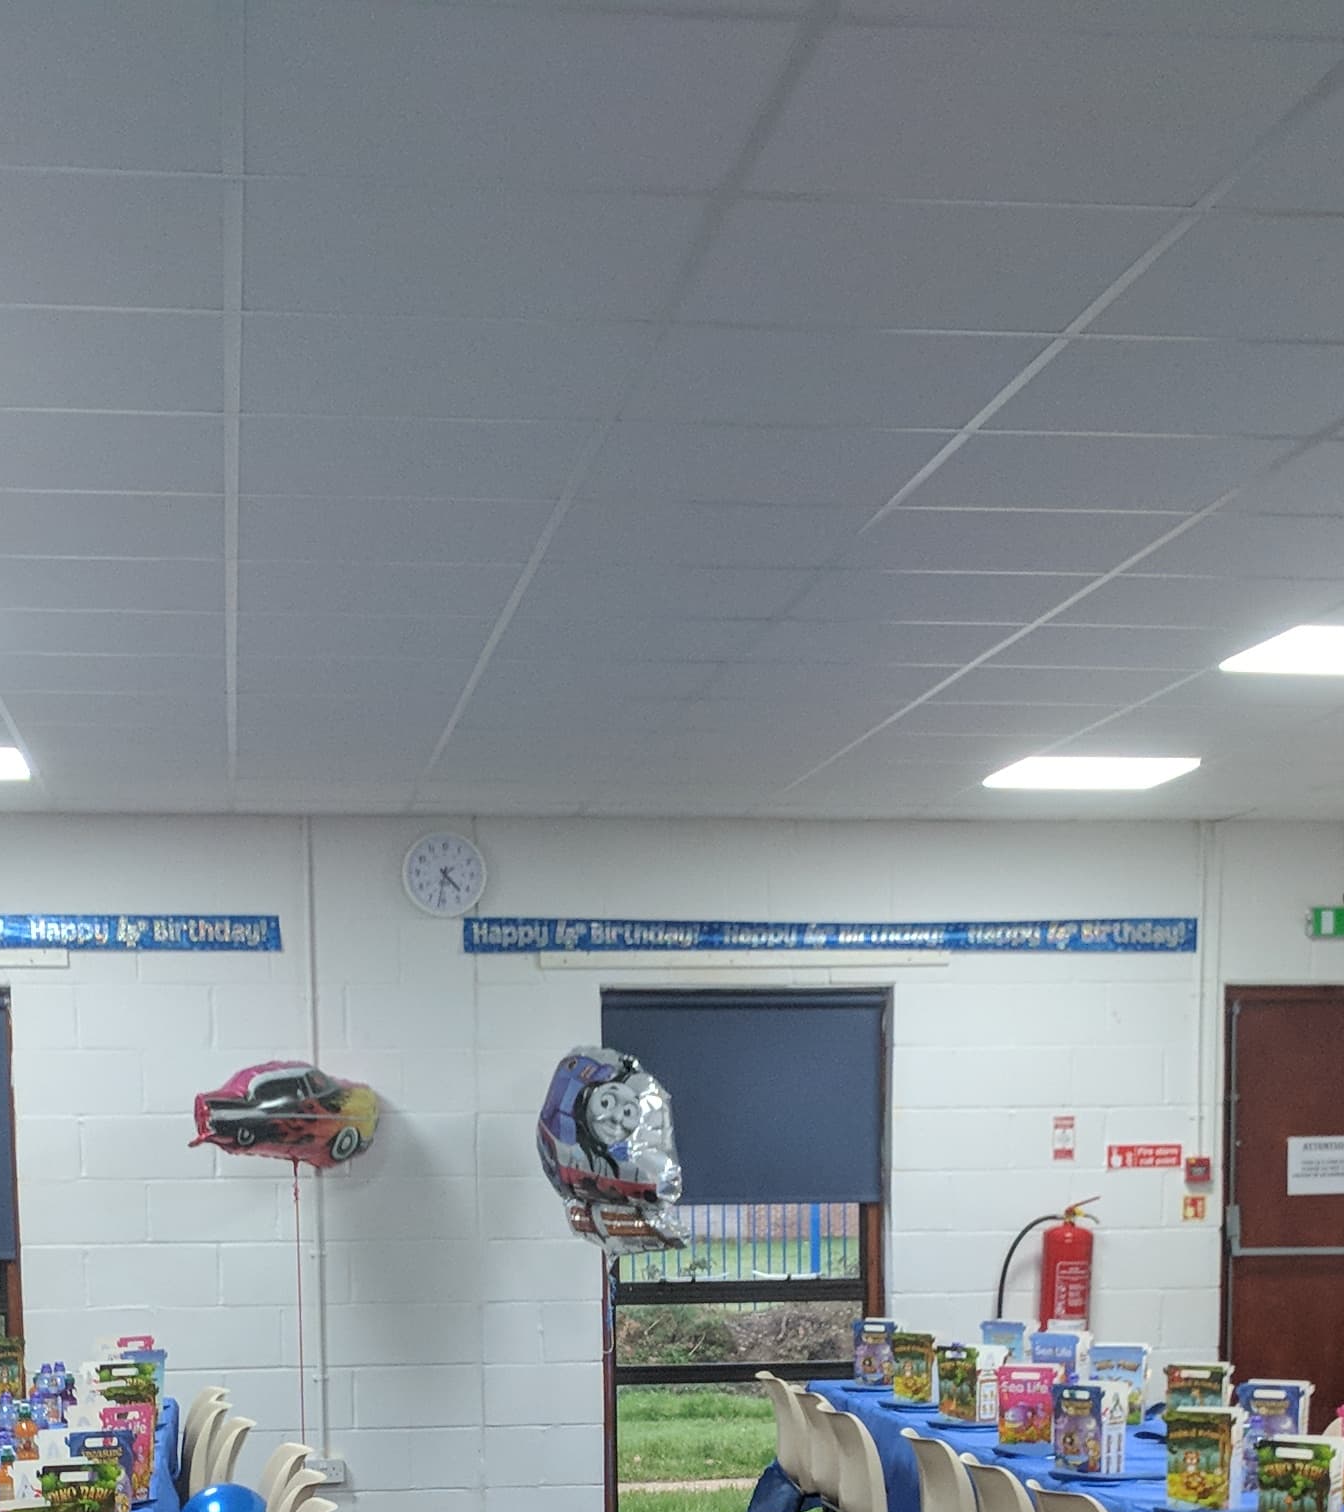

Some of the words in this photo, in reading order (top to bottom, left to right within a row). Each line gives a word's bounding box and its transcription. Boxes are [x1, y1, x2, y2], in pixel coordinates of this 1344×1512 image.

[30, 918, 109, 945] Happy
[152, 917, 268, 946] Birthday!
[472, 921, 549, 948] Happy
[1001, 1381, 1024, 1394] Sea
[1026, 1381, 1049, 1395] Life
[48, 1485, 77, 1502] DINO
